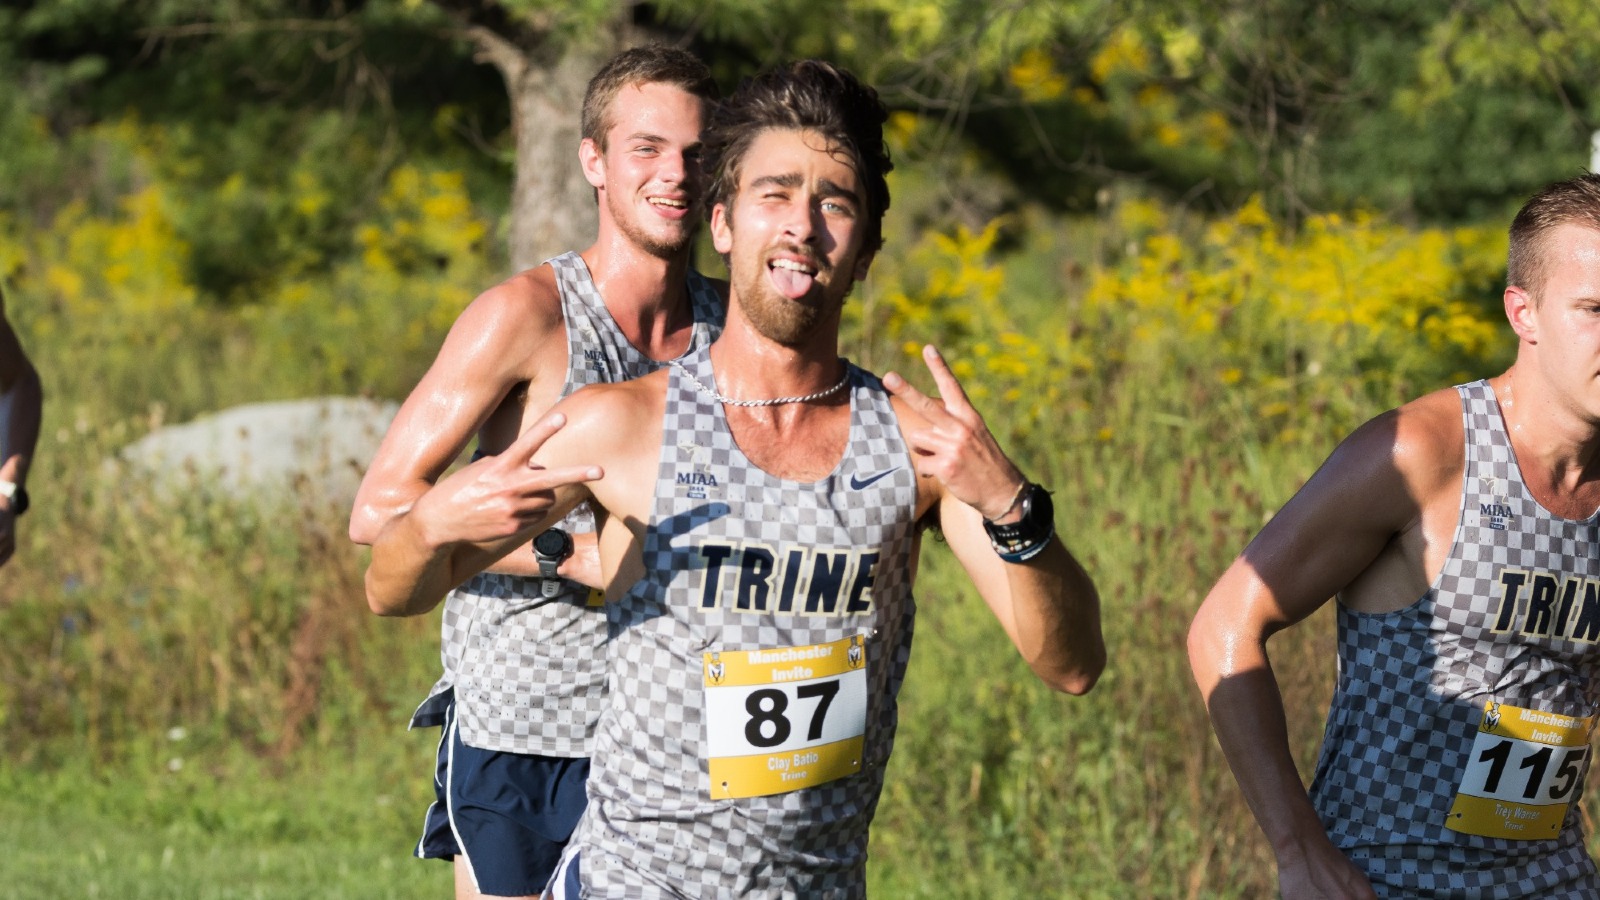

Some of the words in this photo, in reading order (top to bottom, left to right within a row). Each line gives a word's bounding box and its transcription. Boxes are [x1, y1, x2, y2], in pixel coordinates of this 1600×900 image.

[584, 349, 608, 361] MIA
[677, 472, 718, 486] MIAA
[1480, 504, 1514, 518] MIAA
[697, 540, 880, 616] TRINE
[748, 646, 833, 665] Manchester
[772, 667, 813, 681] Invite
[744, 679, 840, 748] 87
[1520, 709, 1583, 728] Manchester
[1531, 729, 1563, 743] Invite
[768, 756, 790, 771] Clay
[1478, 740, 1586, 800] 115
[780, 771, 807, 782] Trine
[1495, 803, 1512, 820] Trey
